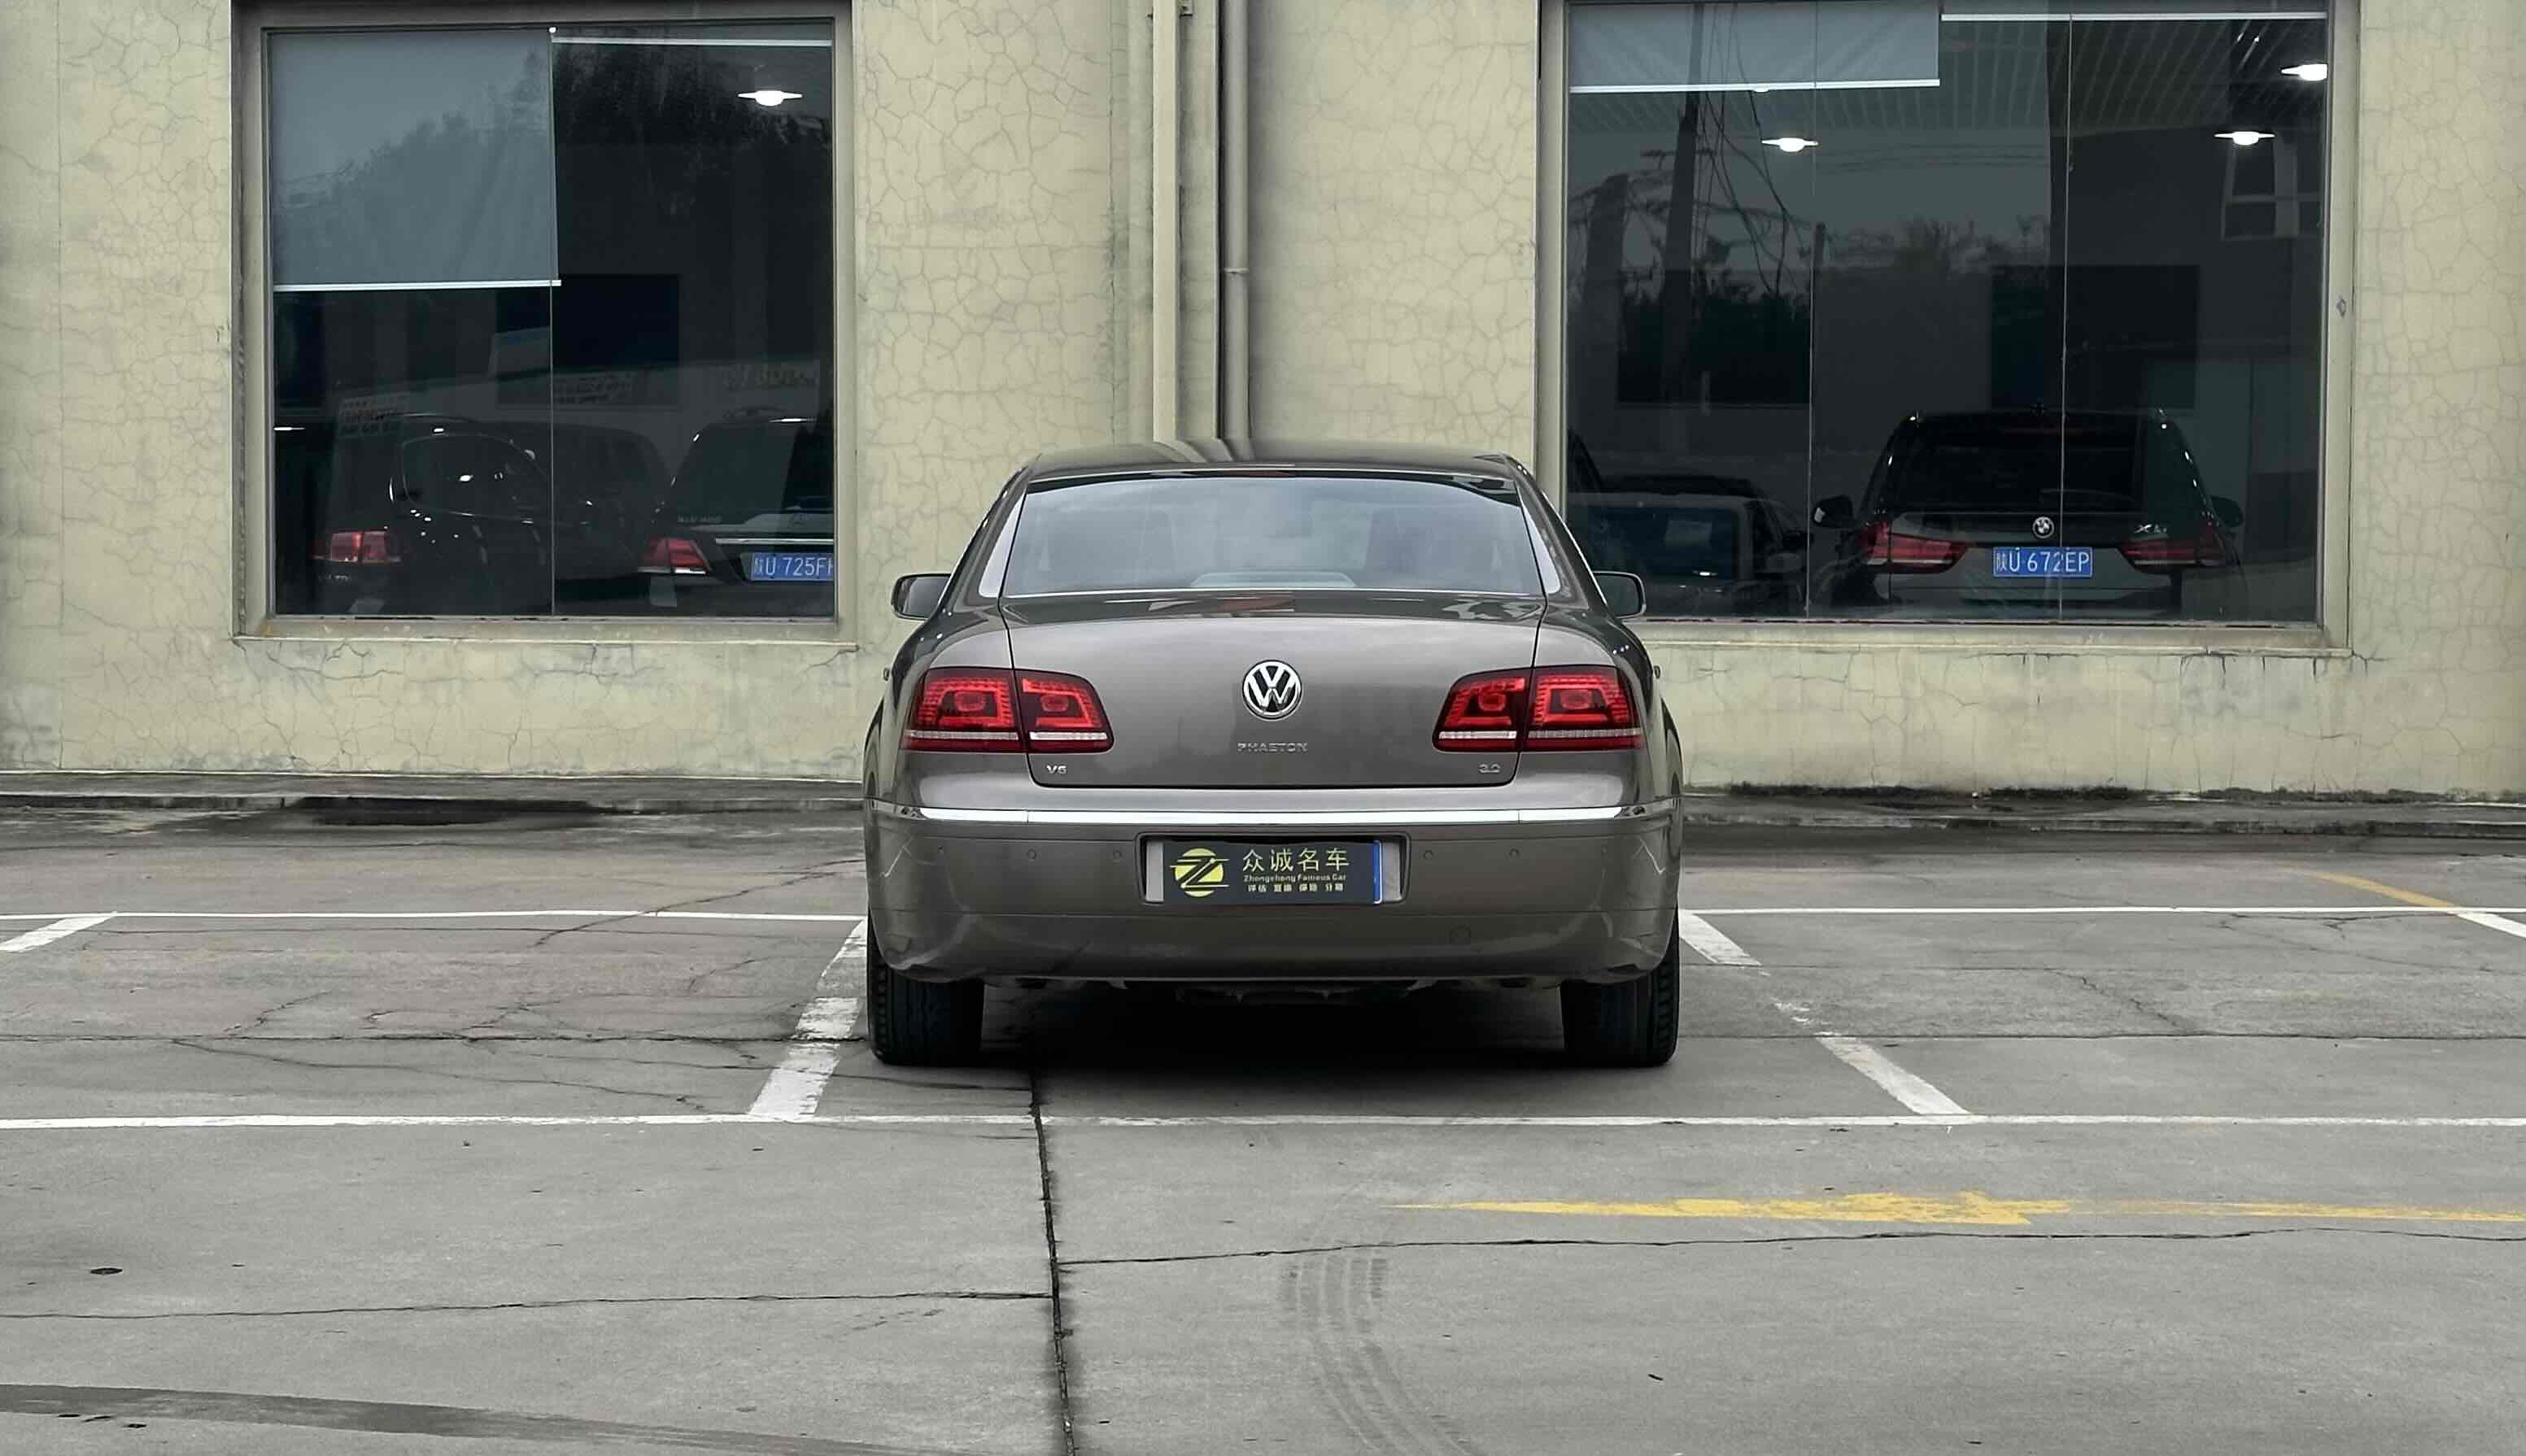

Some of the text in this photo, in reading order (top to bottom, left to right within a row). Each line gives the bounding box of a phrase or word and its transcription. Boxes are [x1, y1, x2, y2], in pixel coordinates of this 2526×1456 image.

[1241, 847, 1350, 872] 众诚名车
[1297, 873, 1331, 882] Famous
[1332, 873, 1347, 882] Car
